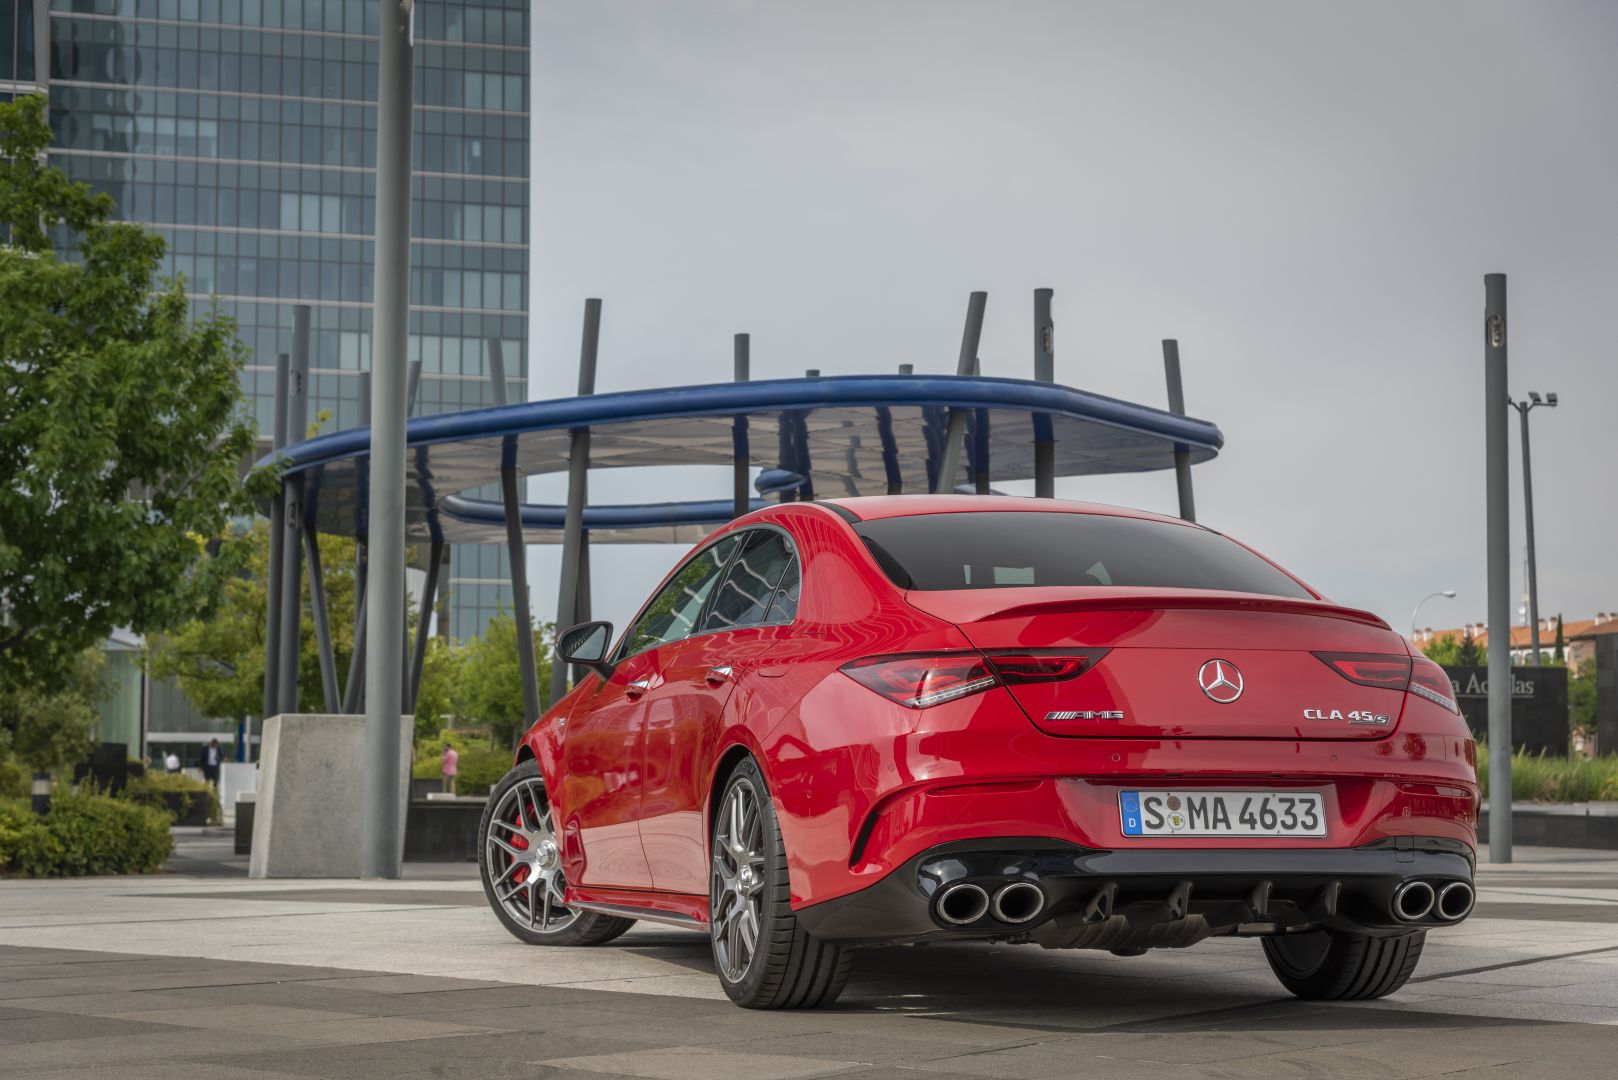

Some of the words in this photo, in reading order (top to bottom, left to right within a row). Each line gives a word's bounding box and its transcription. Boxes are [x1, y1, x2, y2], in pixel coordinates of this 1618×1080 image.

[1303, 709, 1344, 720] CLA
[1144, 797, 1165, 830] S
[1186, 797, 1232, 830] MA
[1238, 797, 1318, 830] 4633
[1128, 818, 1137, 828] D
